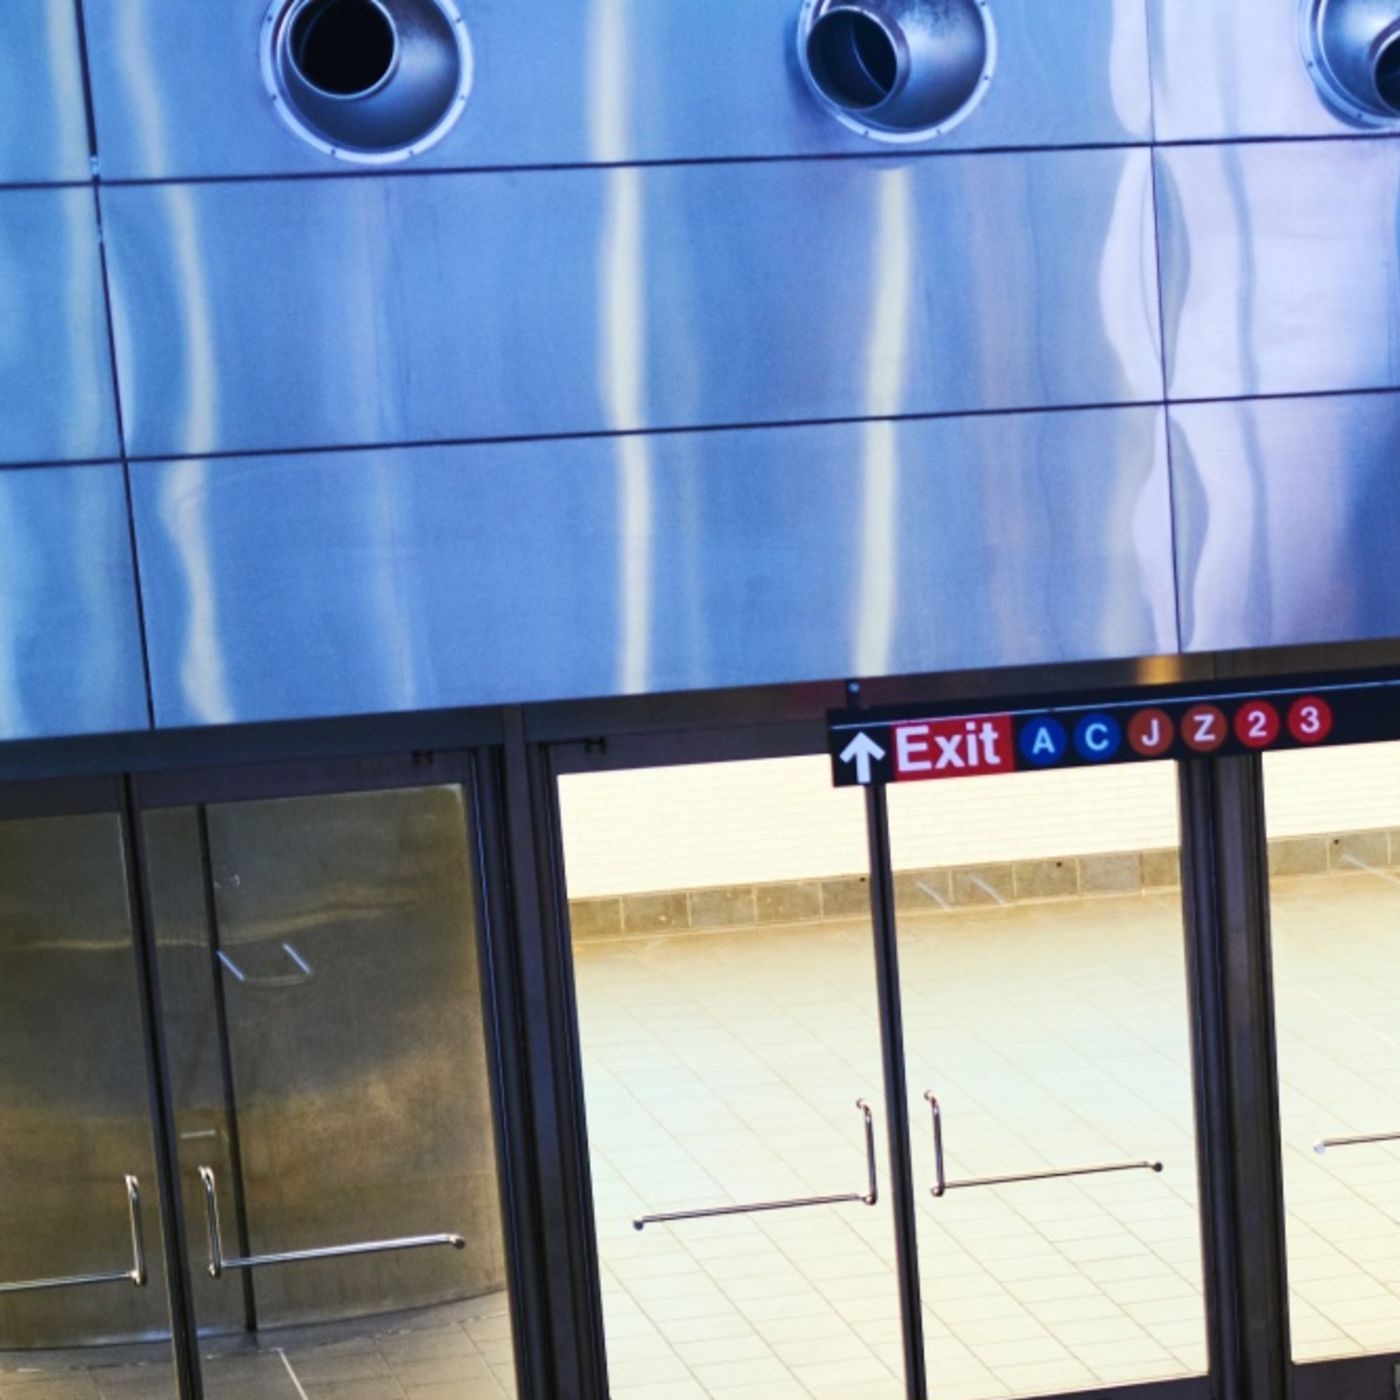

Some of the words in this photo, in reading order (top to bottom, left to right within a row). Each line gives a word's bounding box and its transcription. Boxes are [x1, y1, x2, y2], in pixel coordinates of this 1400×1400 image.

[895, 720, 1001, 773] Exit
[1032, 727, 1055, 754] A
[1085, 723, 1109, 751] C
[1141, 719, 1160, 747] J
[1194, 714, 1216, 742] Z
[1247, 710, 1267, 738] 2
[1300, 706, 1320, 734] 3
